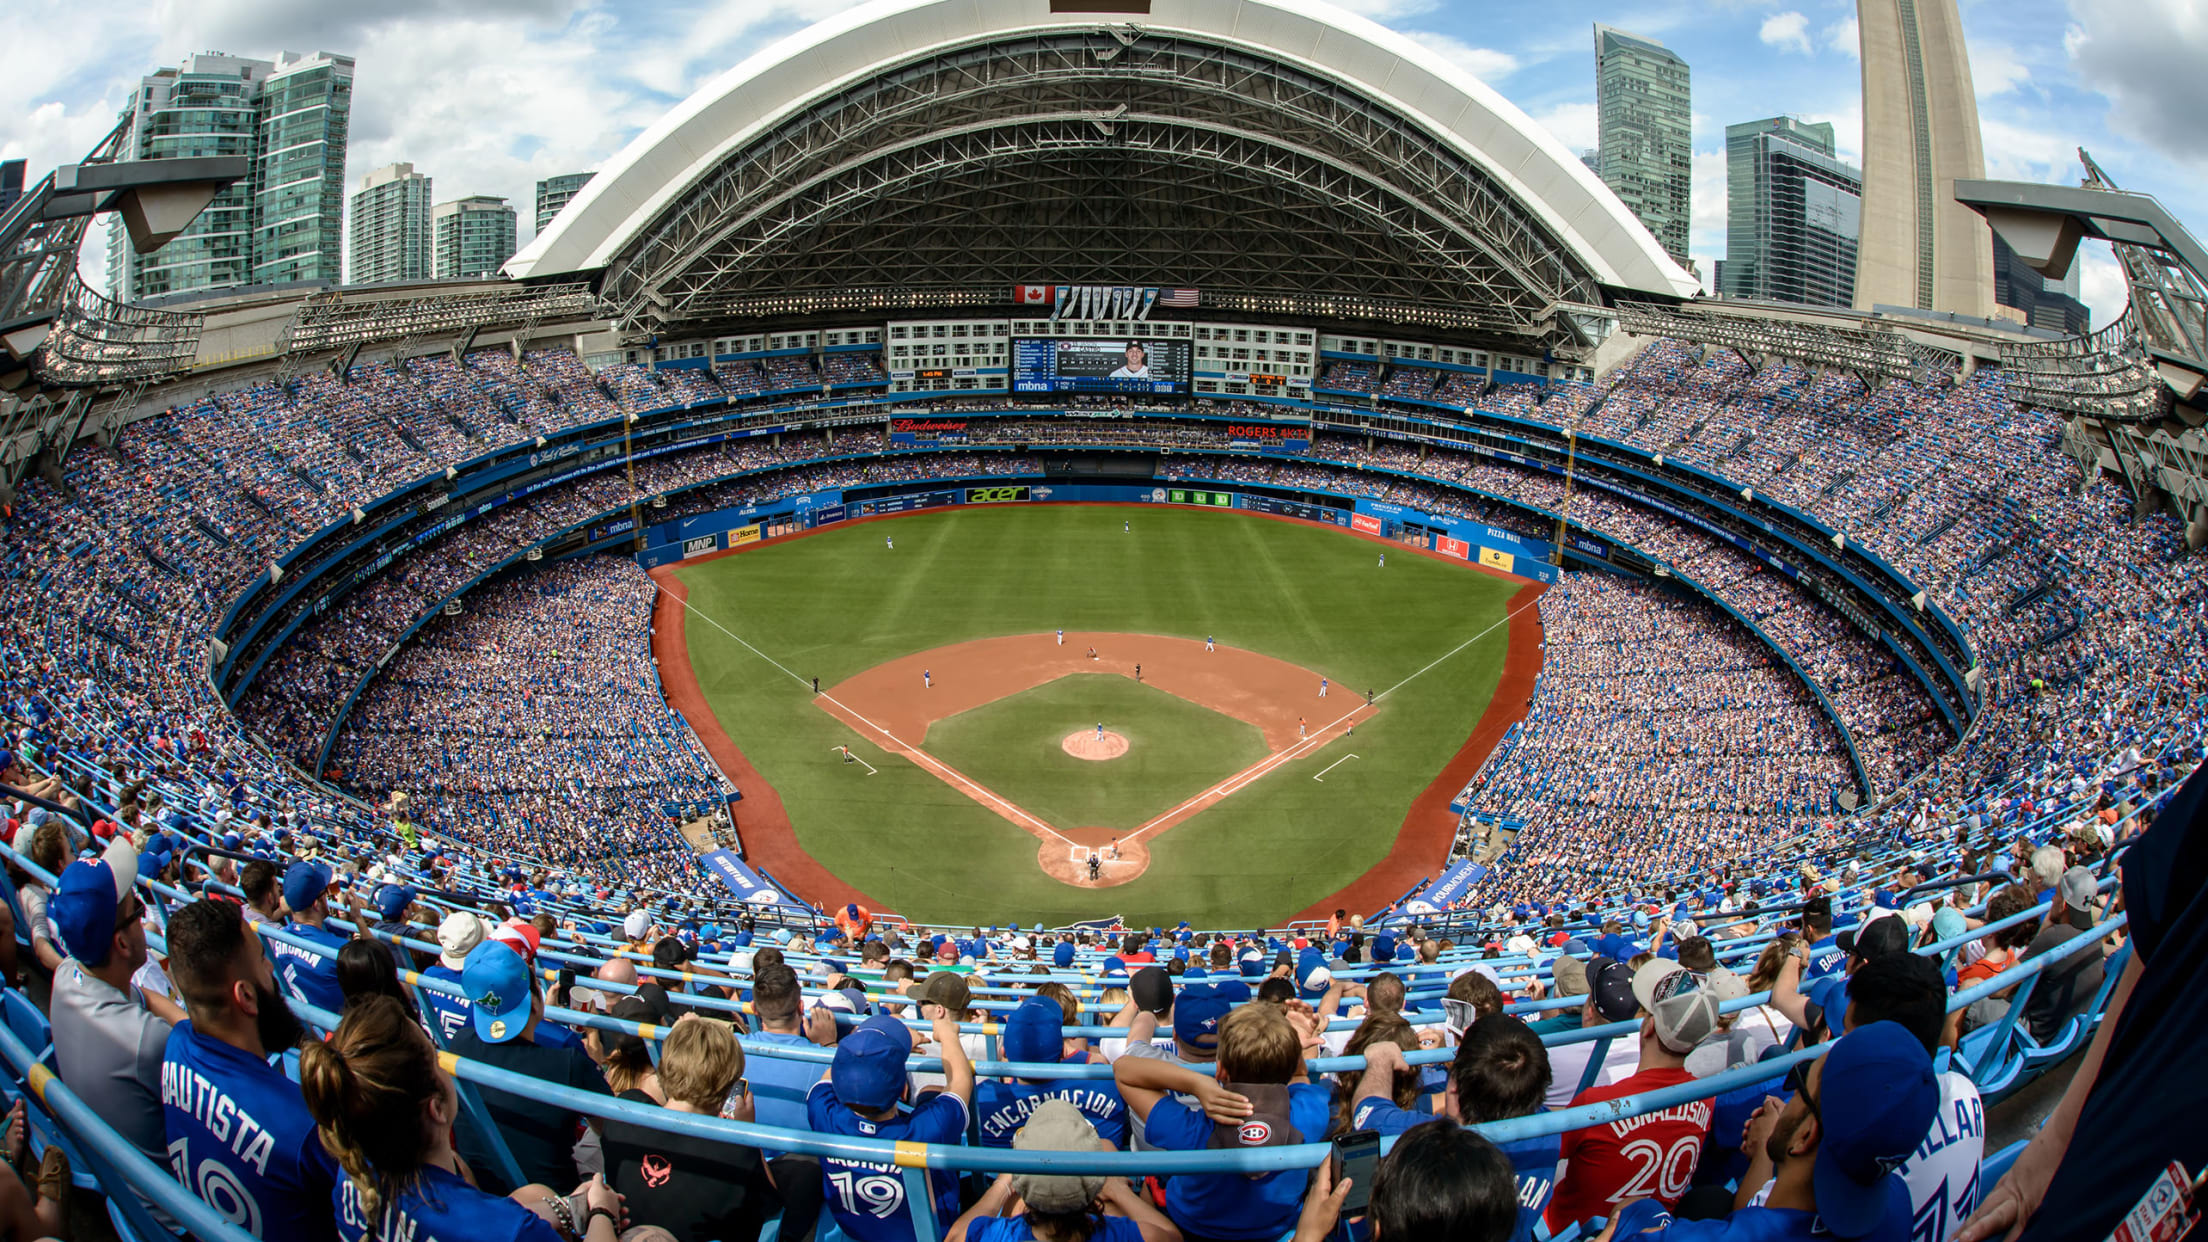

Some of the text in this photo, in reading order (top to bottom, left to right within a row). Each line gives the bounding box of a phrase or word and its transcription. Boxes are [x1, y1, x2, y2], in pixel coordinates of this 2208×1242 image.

[1018, 381, 1048, 391] mbna
[894, 419, 967, 432] Budweiser
[1228, 426, 1277, 438] ROGERS
[971, 487, 1024, 502] acer
[1196, 494, 1205, 502] TD
[609, 520, 633, 534] mbna
[739, 527, 759, 539] Home
[1487, 528, 1505, 539] PIZZA
[687, 538, 712, 552] MNP
[1578, 540, 1602, 555] mbna
[1431, 862, 1478, 903] #OURMOMENT
[161, 1060, 275, 1177] BAUTISTA
[1899, 1098, 1984, 1177] LLAR
[1604, 1135, 1701, 1203] 20
[826, 1171, 904, 1219] 19
